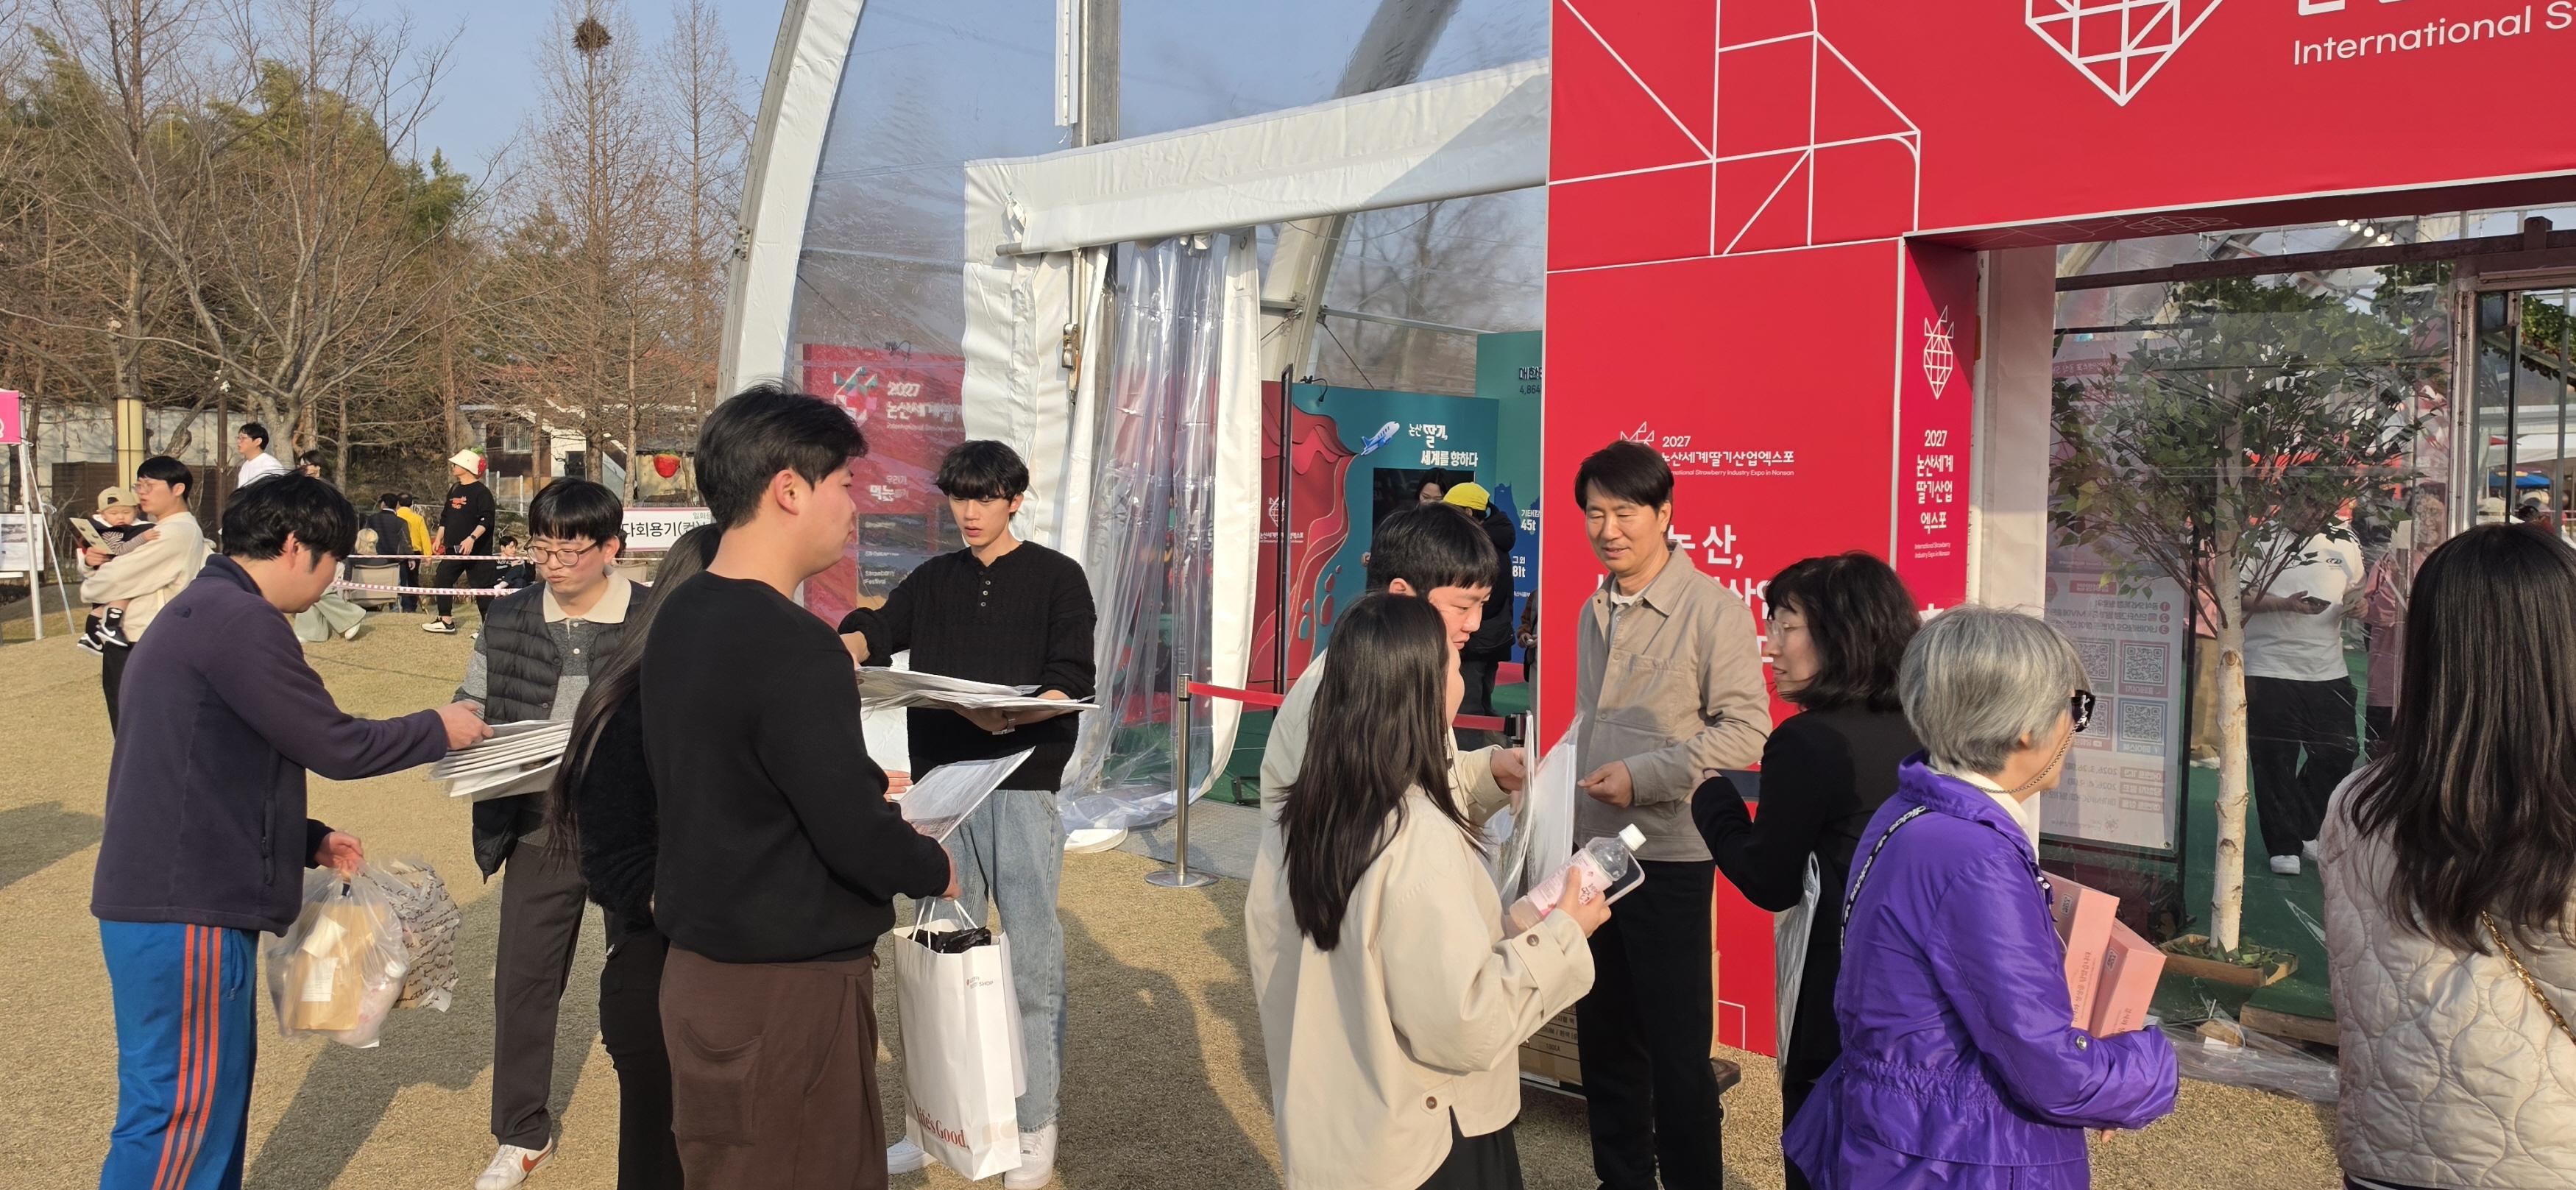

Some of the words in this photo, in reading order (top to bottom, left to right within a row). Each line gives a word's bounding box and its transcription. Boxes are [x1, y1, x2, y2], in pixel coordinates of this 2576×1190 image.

[2293, 5, 2531, 65] International
[2546, 1, 2576, 30] S
[1519, 366, 1542, 380] 대한
[887, 380, 921, 397] 2027
[1520, 384, 1540, 395] 4,864
[1409, 423, 1423, 437] 논산
[1423, 424, 1448, 449] 딸기,
[1662, 436, 1691, 447] 2027
[1923, 429, 1948, 447] 2027
[1420, 450, 1449, 466] 세계를
[1450, 450, 1479, 467] 향하다
[1661, 450, 1794, 467] 논산세계딸기산업엑스포
[1916, 454, 1954, 478] 논산세계
[1916, 481, 1953, 504] 딸기산업
[1521, 519, 1537, 531] 45t
[1920, 511, 1947, 535] 엑스포
[1512, 565, 1526, 578] 81t
[935, 1119, 970, 1150] Good.
